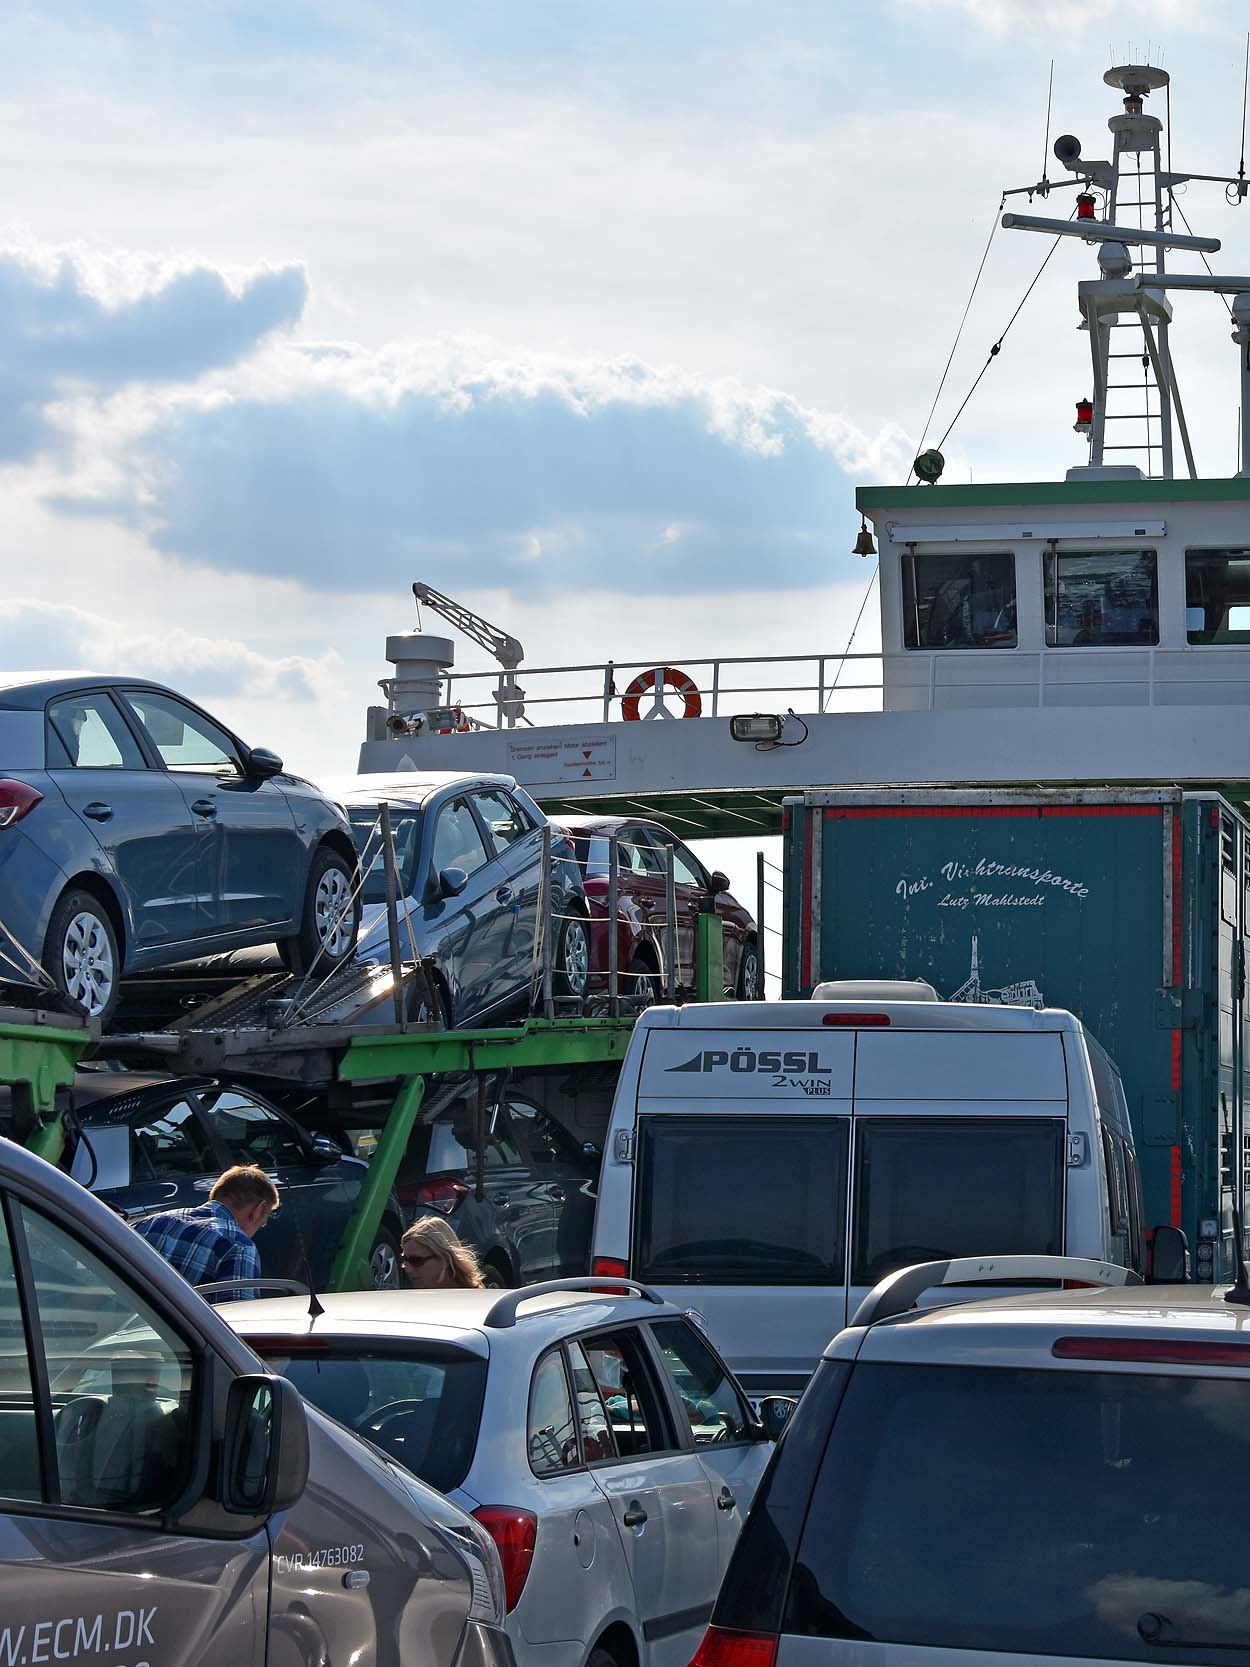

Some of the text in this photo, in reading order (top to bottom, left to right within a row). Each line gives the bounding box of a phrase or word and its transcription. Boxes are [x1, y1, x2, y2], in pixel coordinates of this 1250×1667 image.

[937, 893, 1045, 909] Lutz Mahlstedt
[703, 1047, 832, 1073] PÖSSL
[806, 1087, 831, 1096] PLUS
[277, 1544, 364, 1574] CVR 14763082
